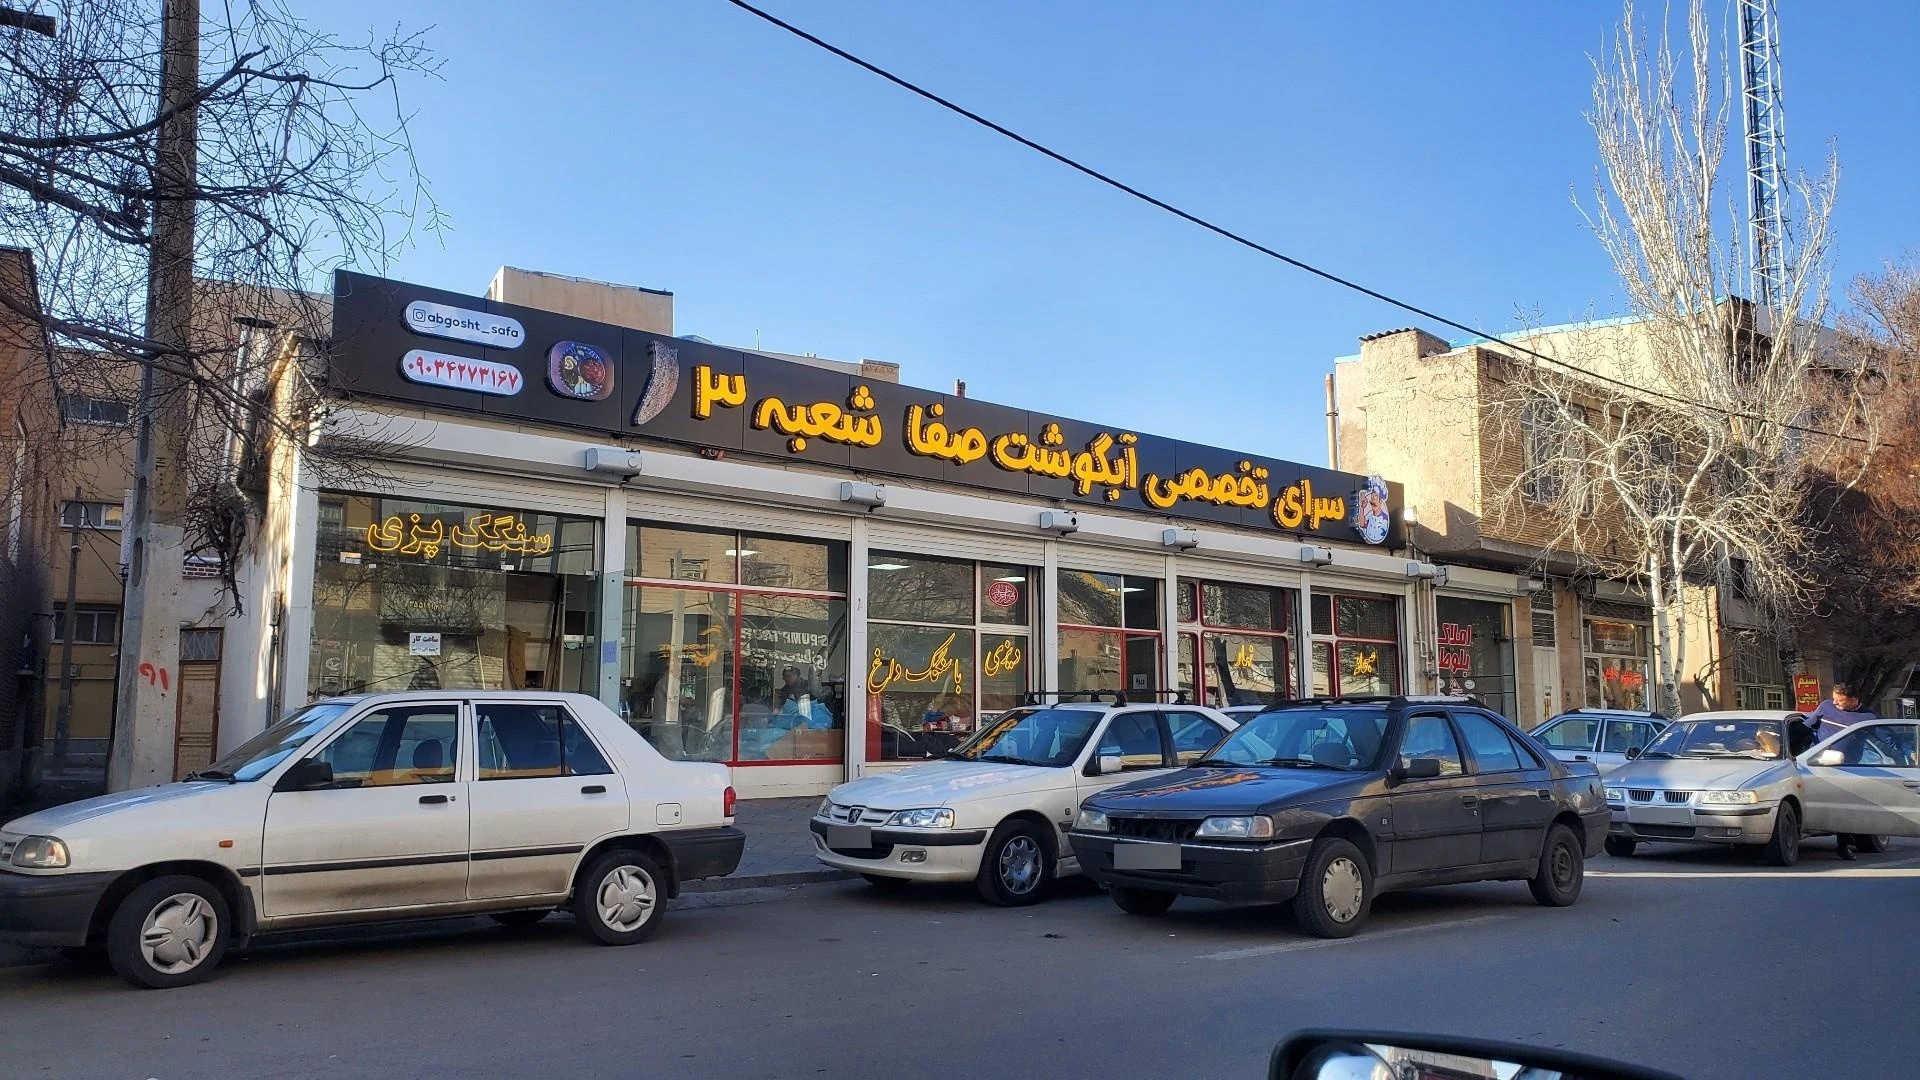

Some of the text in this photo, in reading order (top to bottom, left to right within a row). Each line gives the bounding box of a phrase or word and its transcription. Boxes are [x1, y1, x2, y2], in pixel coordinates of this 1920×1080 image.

[428, 312, 519, 338] abgosht_safa
[408, 356, 518, 390] ۰۹۰۳۴۲۷۳۱۶۷
[693, 365, 1345, 531] سرای تخصصی آبگوشت صفا شعبه ۳
[368, 513, 551, 558] سنگک پزی
[1438, 622, 1472, 647] املاک
[867, 647, 902, 694] داغ
[905, 632, 956, 682] سنگک
[985, 639, 1021, 676] دیزی
[1439, 646, 1471, 677] بلوط
[1797, 677, 1817, 689] سیم
